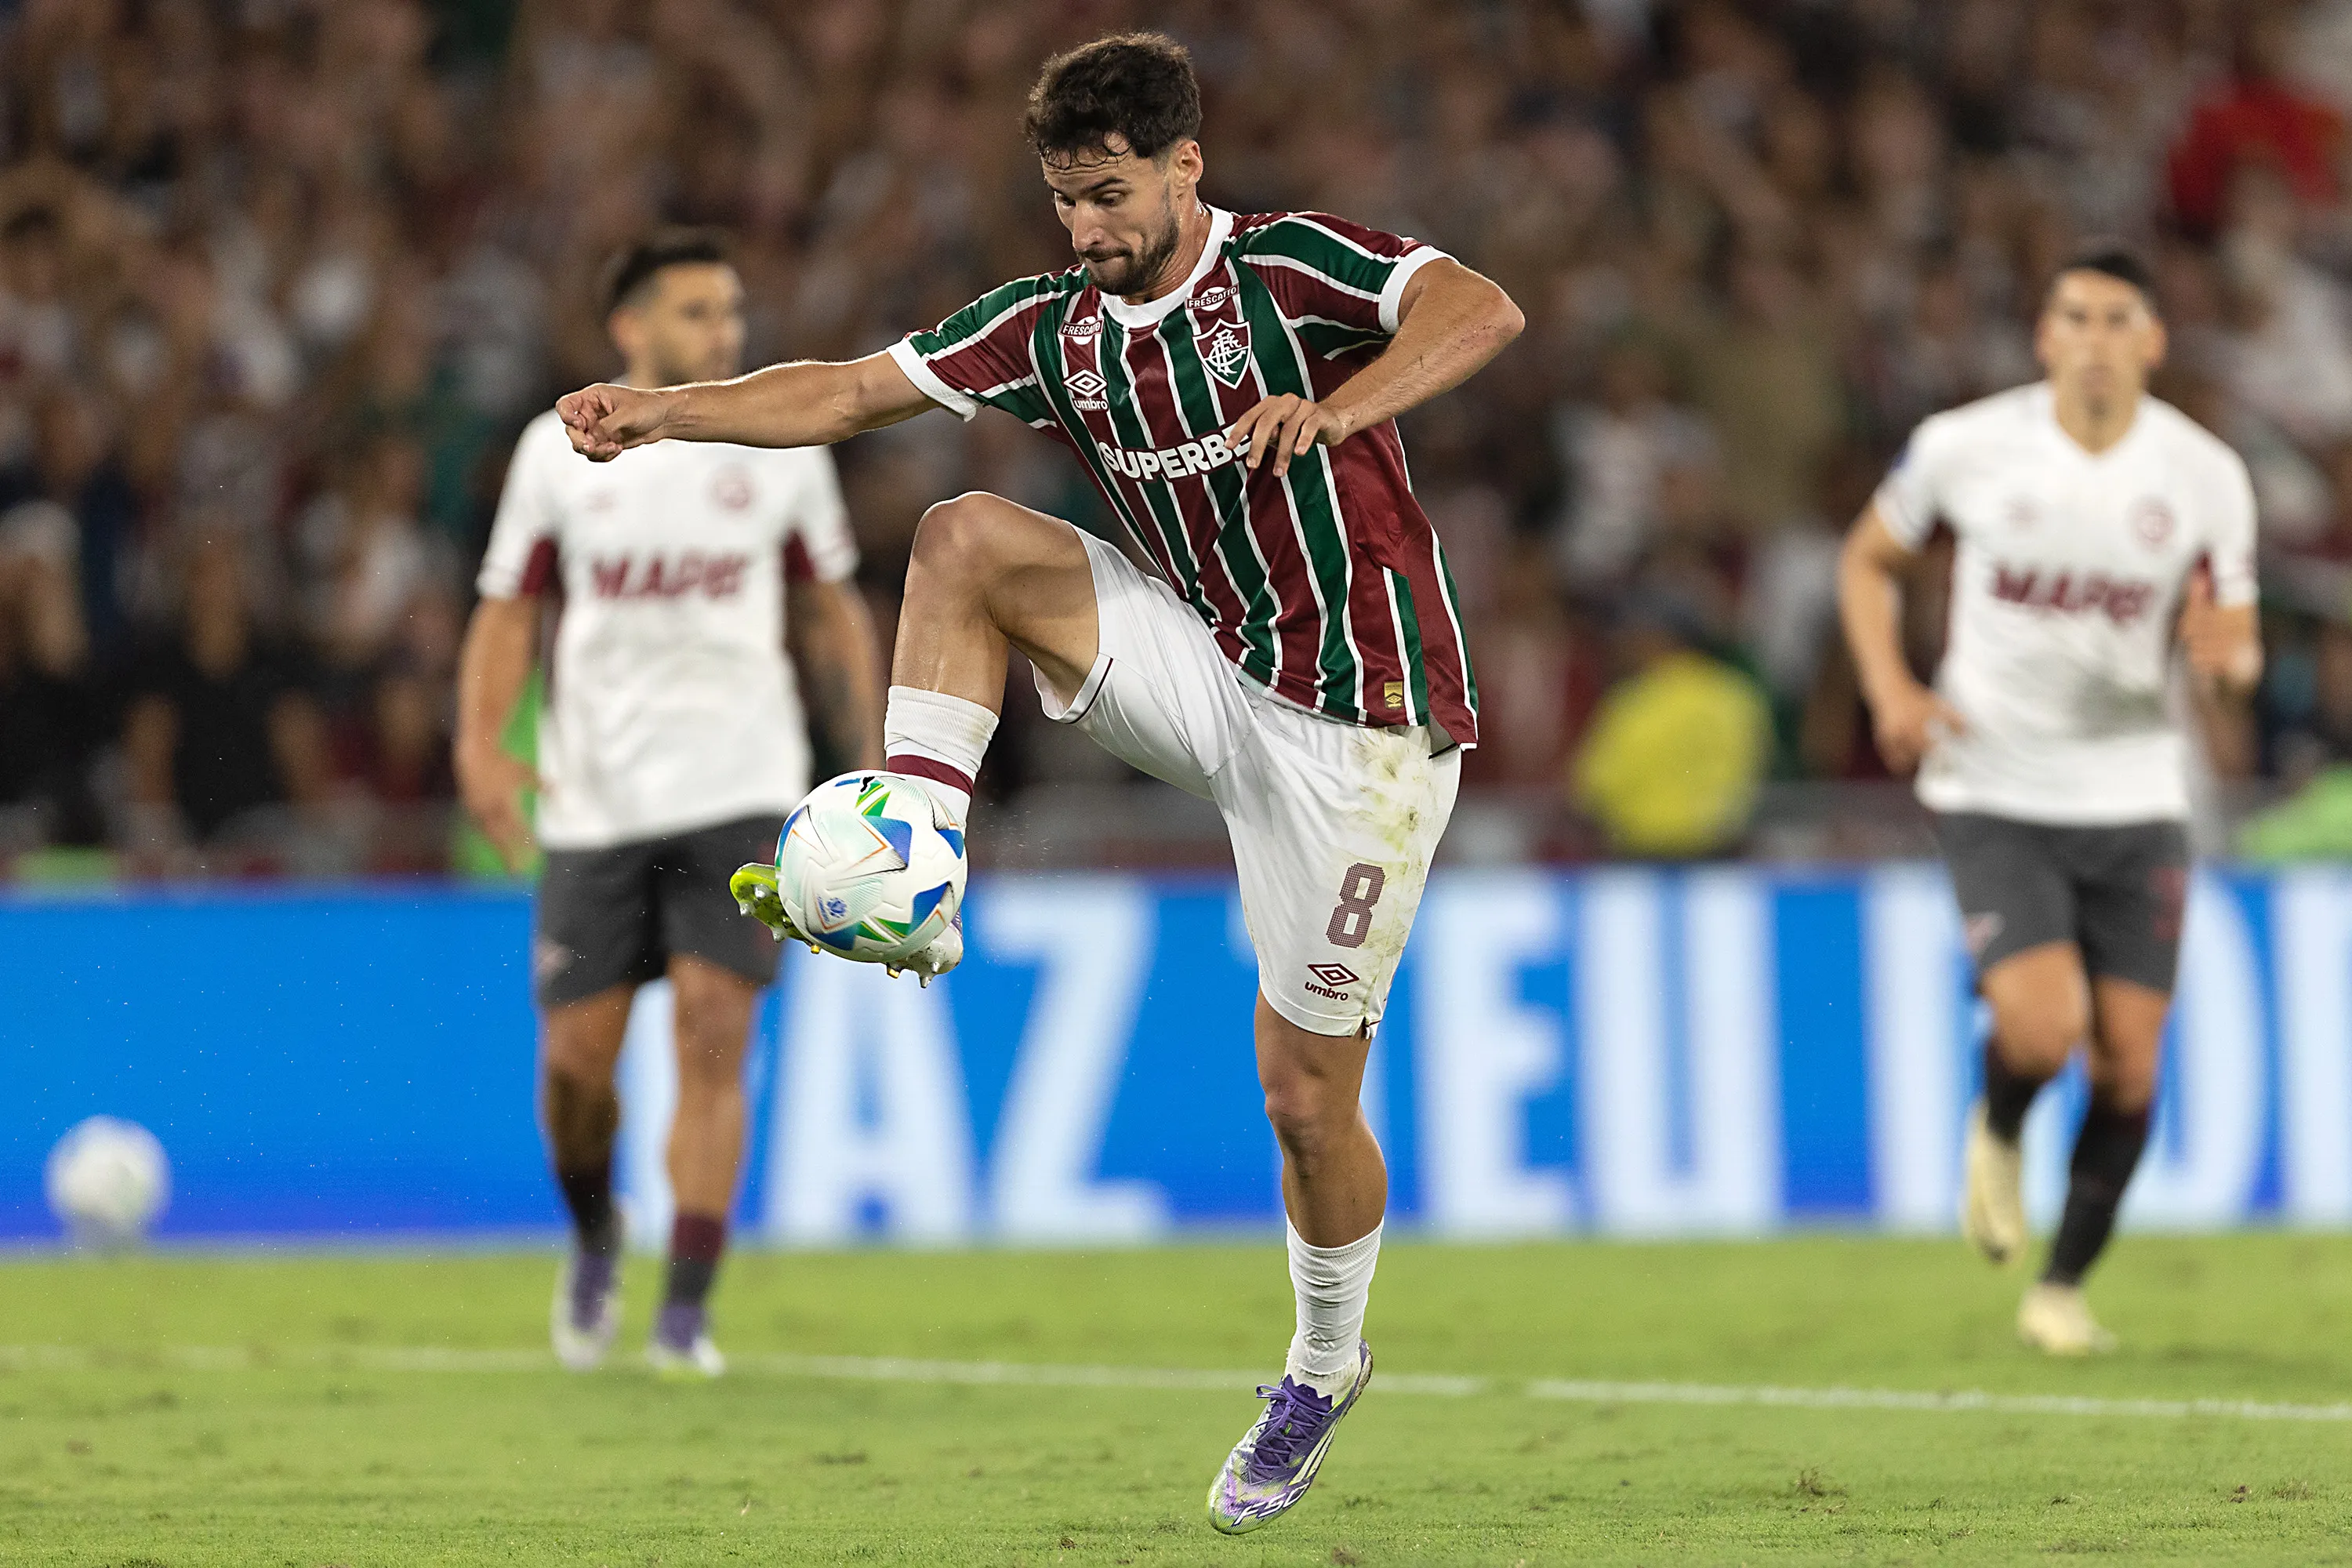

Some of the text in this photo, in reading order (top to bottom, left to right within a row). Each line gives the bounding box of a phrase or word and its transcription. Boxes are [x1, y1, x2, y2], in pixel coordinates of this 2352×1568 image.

[1189, 287, 1236, 307] FRESCATTO
[1062, 321, 1101, 336] FRESCAO
[1073, 397, 1108, 410] umbro
[1326, 862, 1385, 949] 8
[1305, 982, 1348, 1001] umbro
[619, 874, 1170, 1245] AZ
